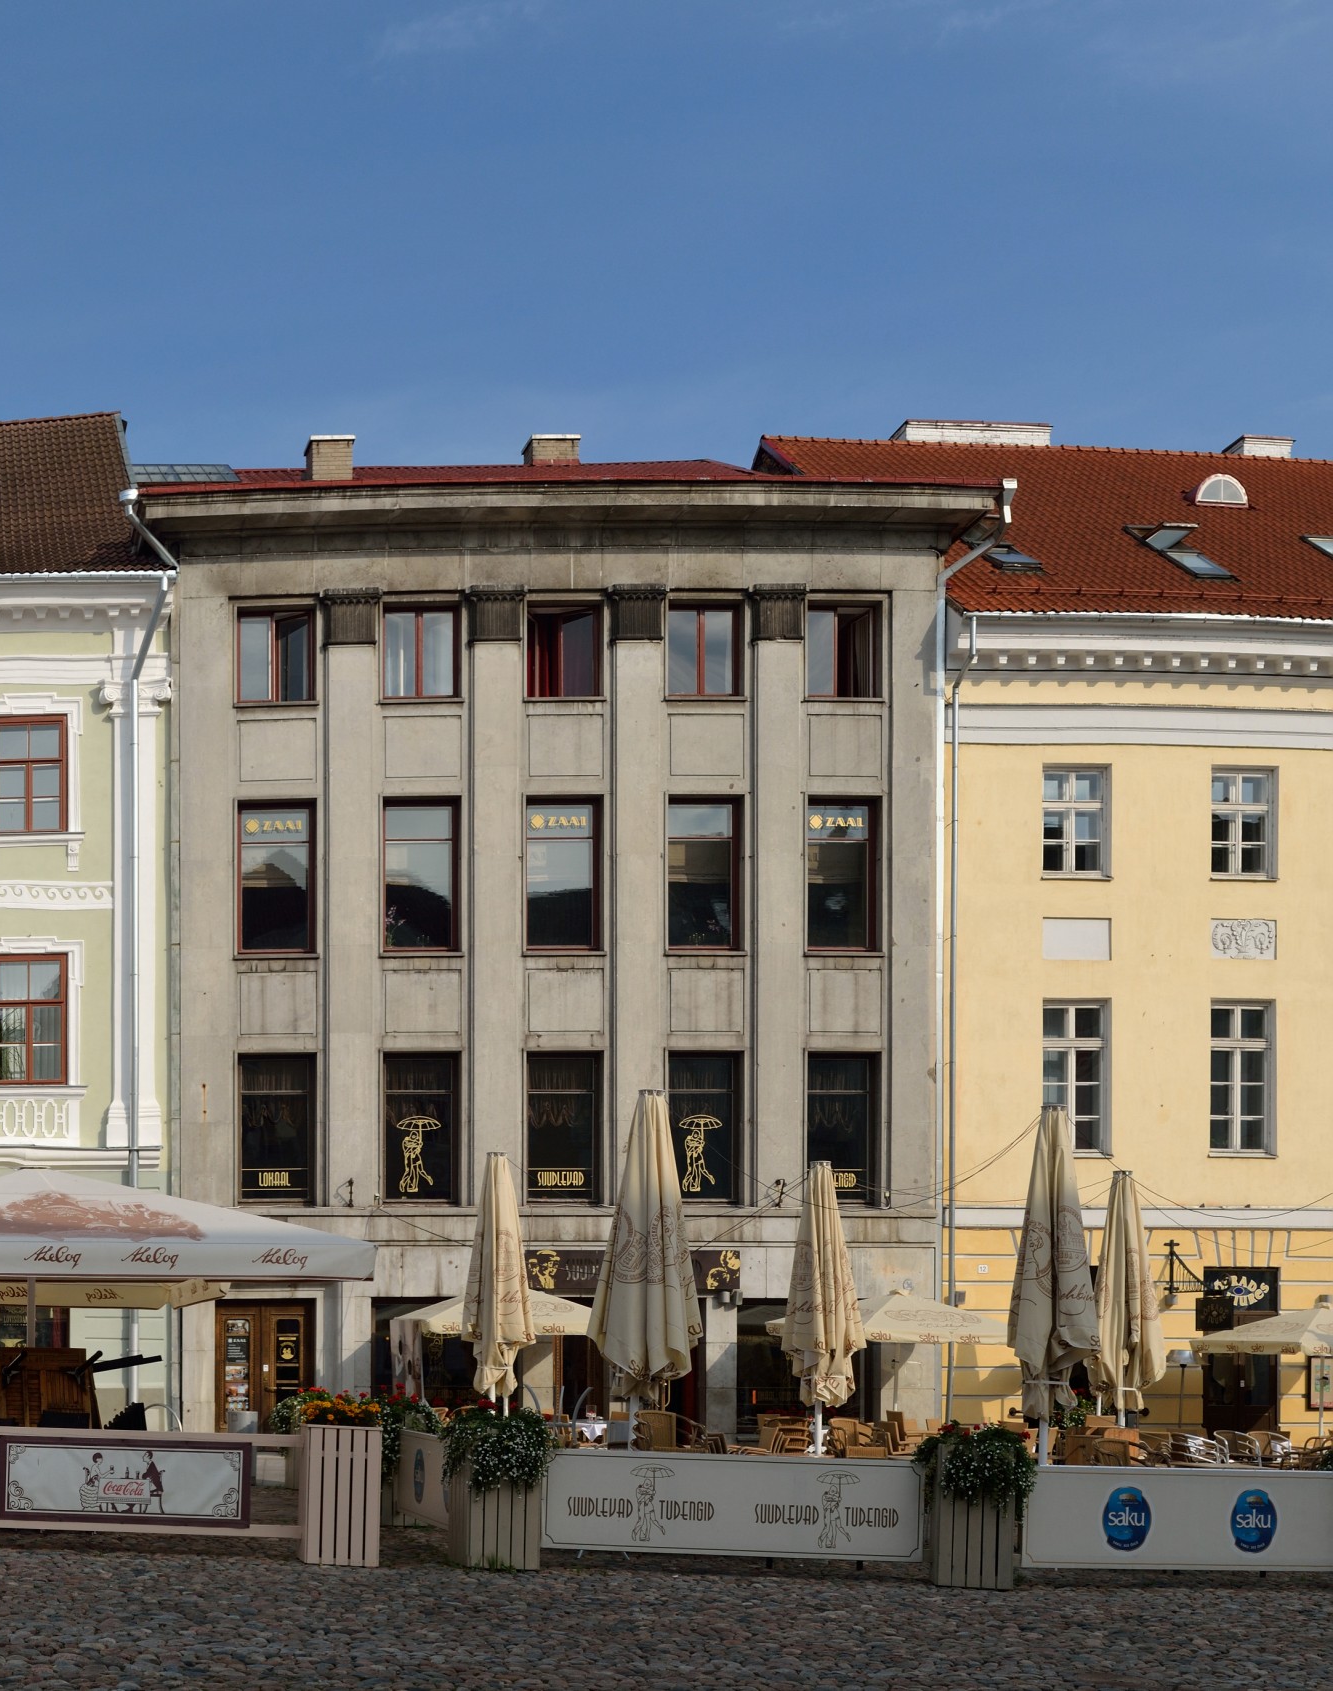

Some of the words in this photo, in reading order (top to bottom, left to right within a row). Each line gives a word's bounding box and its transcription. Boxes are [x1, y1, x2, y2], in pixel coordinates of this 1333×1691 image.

[547, 816, 587, 826] ZAAL
[826, 817, 864, 827] ZAAL
[258, 1171, 291, 1187] LOKAAL
[537, 1171, 585, 1186] SUUDLEVAD
[979, 1265, 988, 1273] 12
[542, 1323, 566, 1334] saku
[870, 1330, 892, 1341] saku
[919, 1332, 940, 1344] saku
[960, 1334, 981, 1345] saku
[568, 1497, 633, 1519] SUUDLEVAD
[659, 1499, 715, 1522] TUDENGID
[754, 1503, 819, 1526] SUUDLEVAD
[844, 1506, 900, 1528] TUDENGID
[1108, 1507, 1145, 1527] saku
[1236, 1509, 1272, 1529] saku
